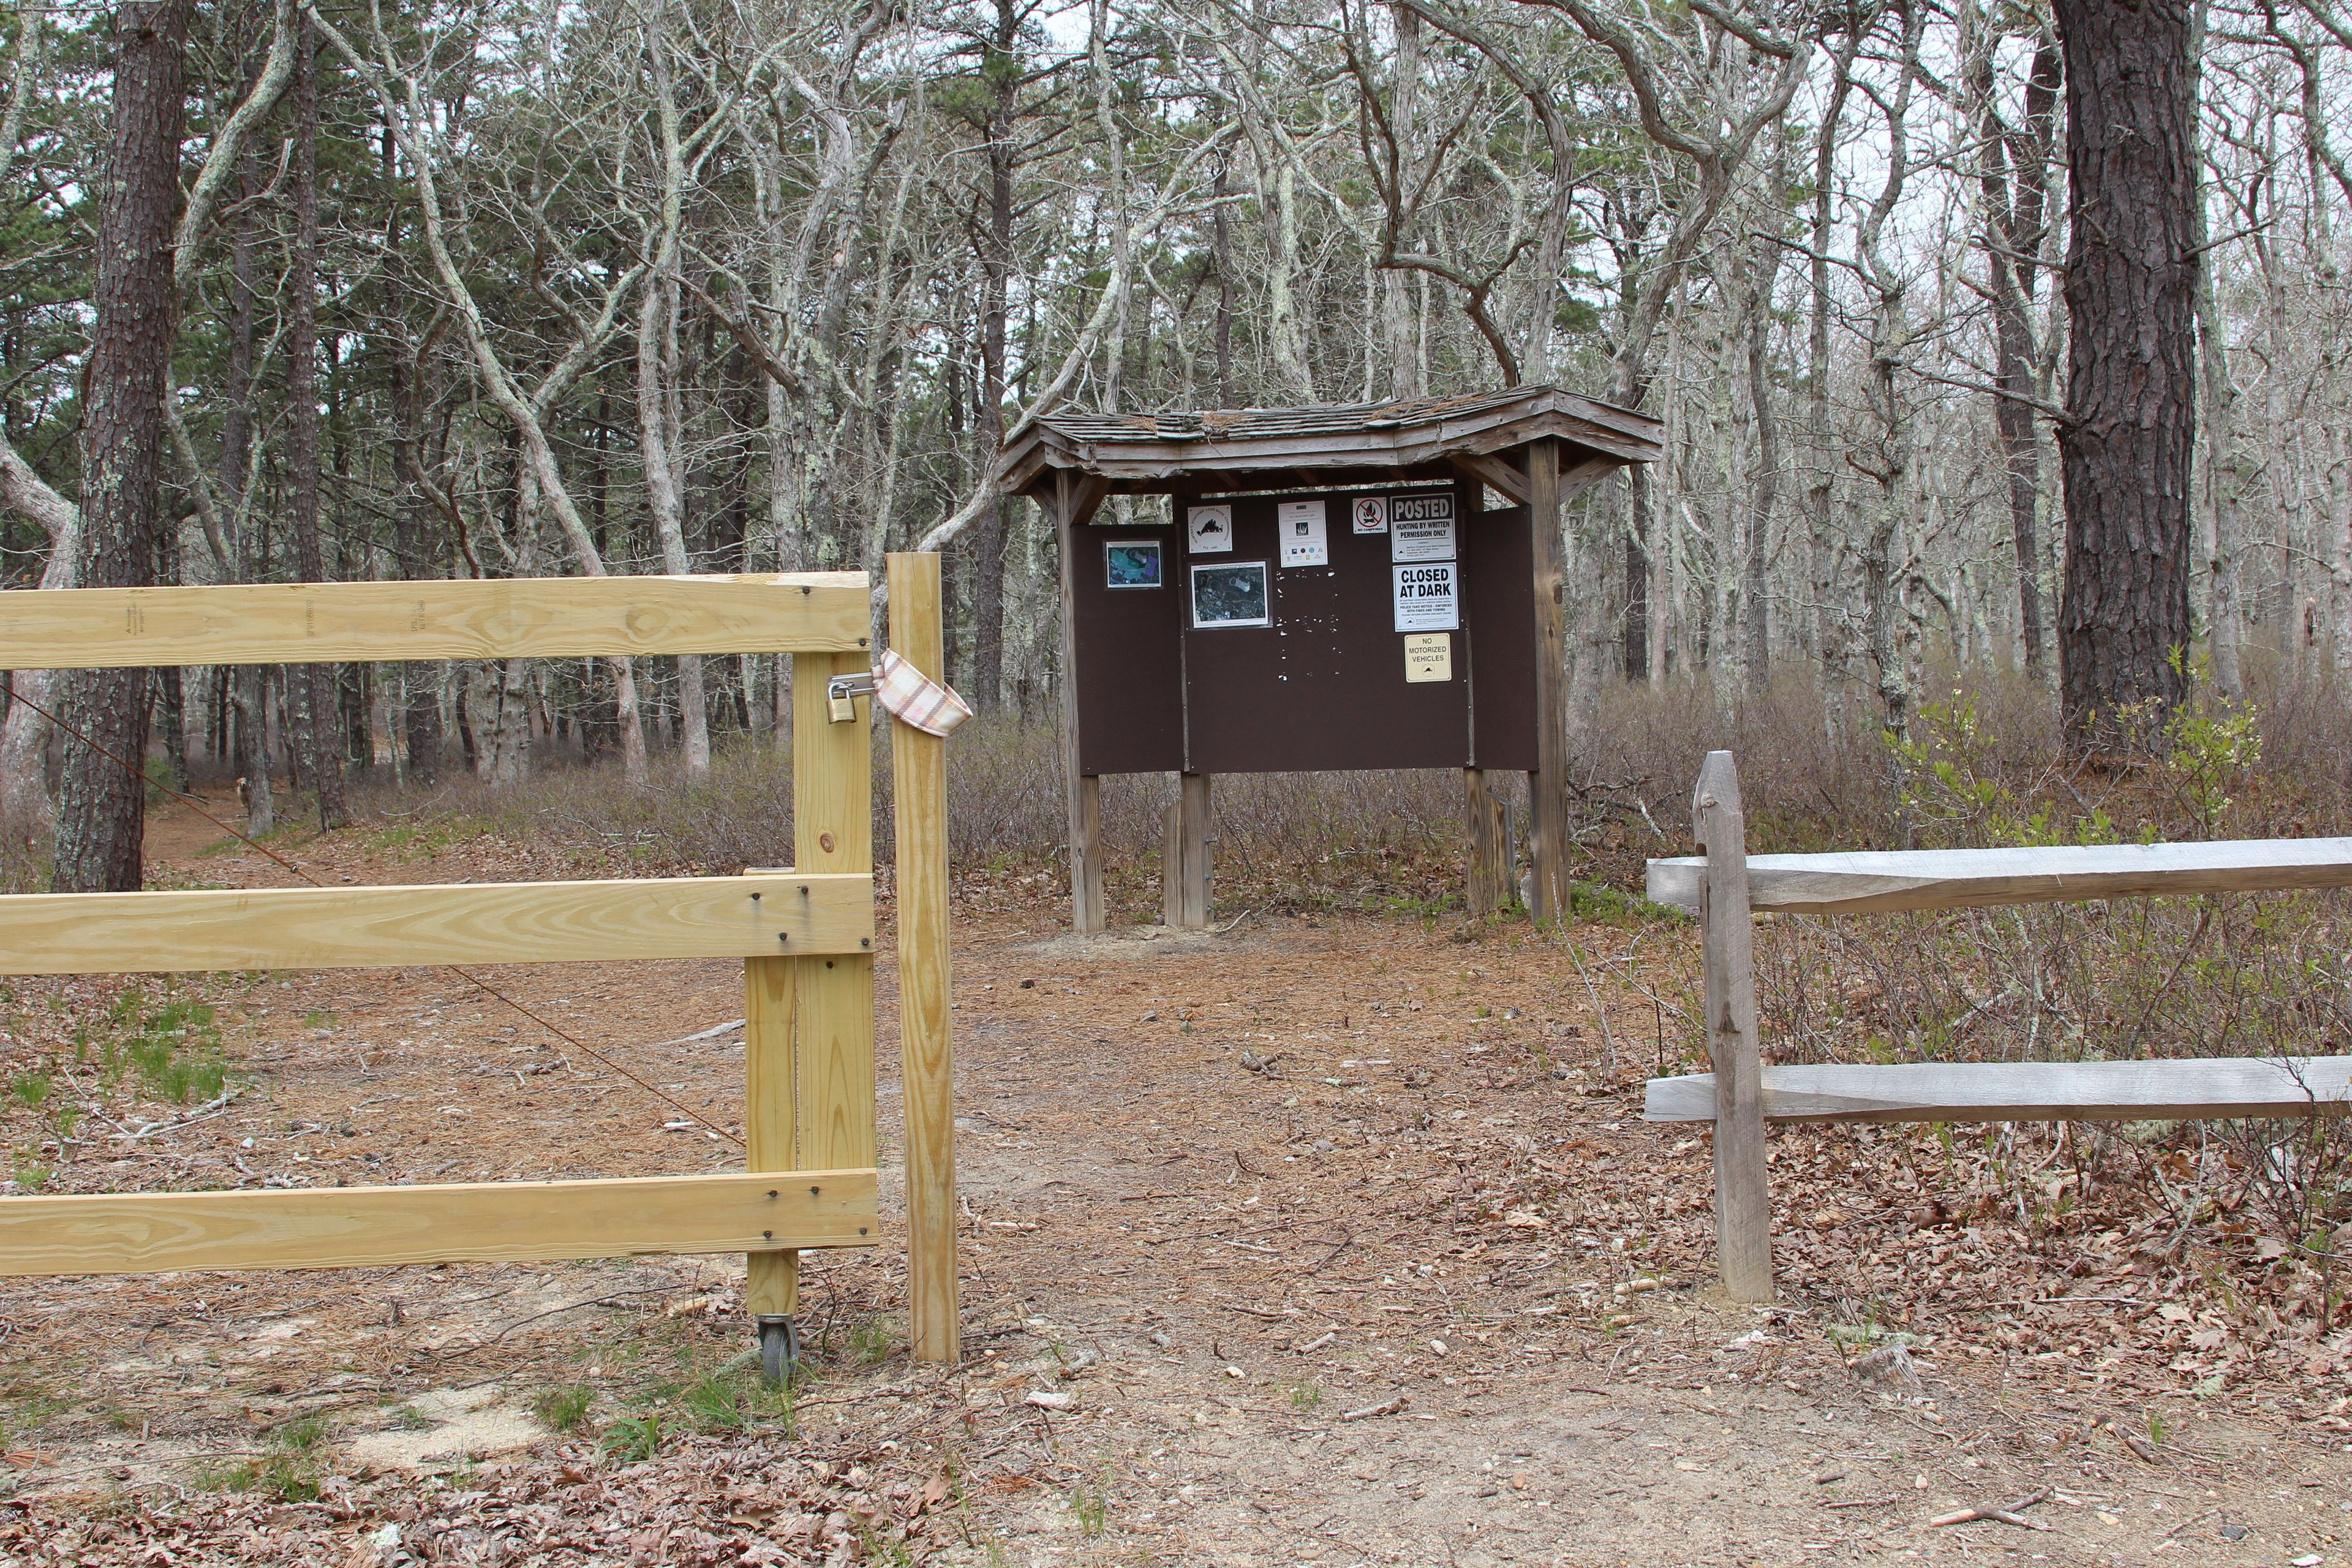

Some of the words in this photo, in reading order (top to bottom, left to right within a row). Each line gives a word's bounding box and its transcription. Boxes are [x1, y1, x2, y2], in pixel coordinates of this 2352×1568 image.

[1395, 499, 1449, 519] POSTED
[1401, 568, 1449, 583] CLOSED
[1400, 585, 1414, 598] AT
[1418, 583, 1451, 597] DARK
